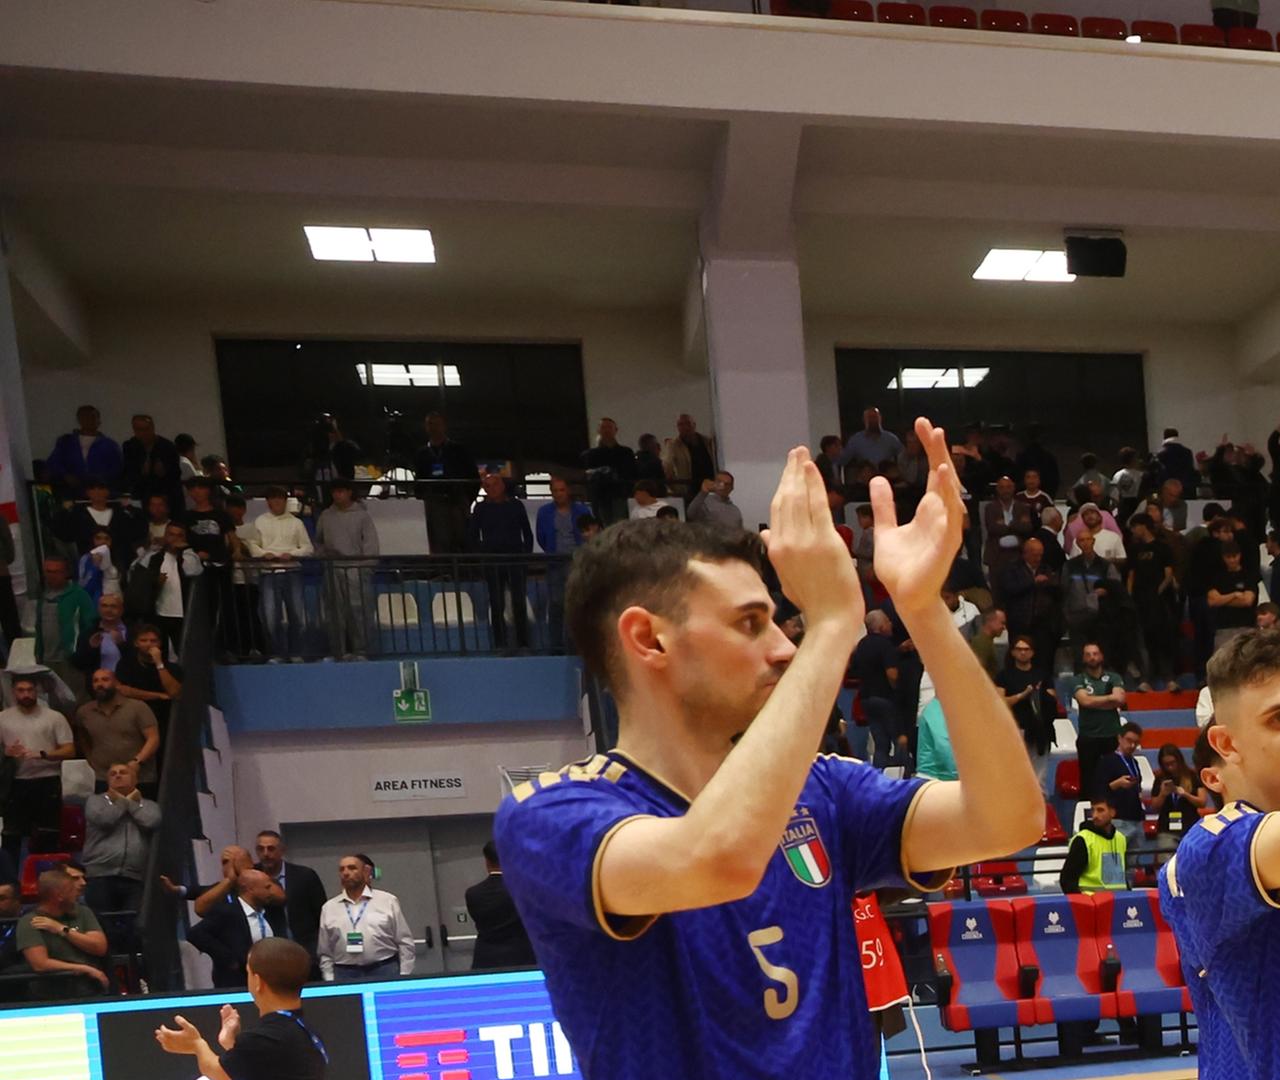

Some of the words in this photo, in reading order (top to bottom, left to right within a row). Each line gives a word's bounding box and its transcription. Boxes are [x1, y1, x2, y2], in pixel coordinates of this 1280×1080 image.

[374, 780, 409, 791] AREA
[411, 778, 462, 789] FITNESS
[748, 925, 799, 1019] 5
